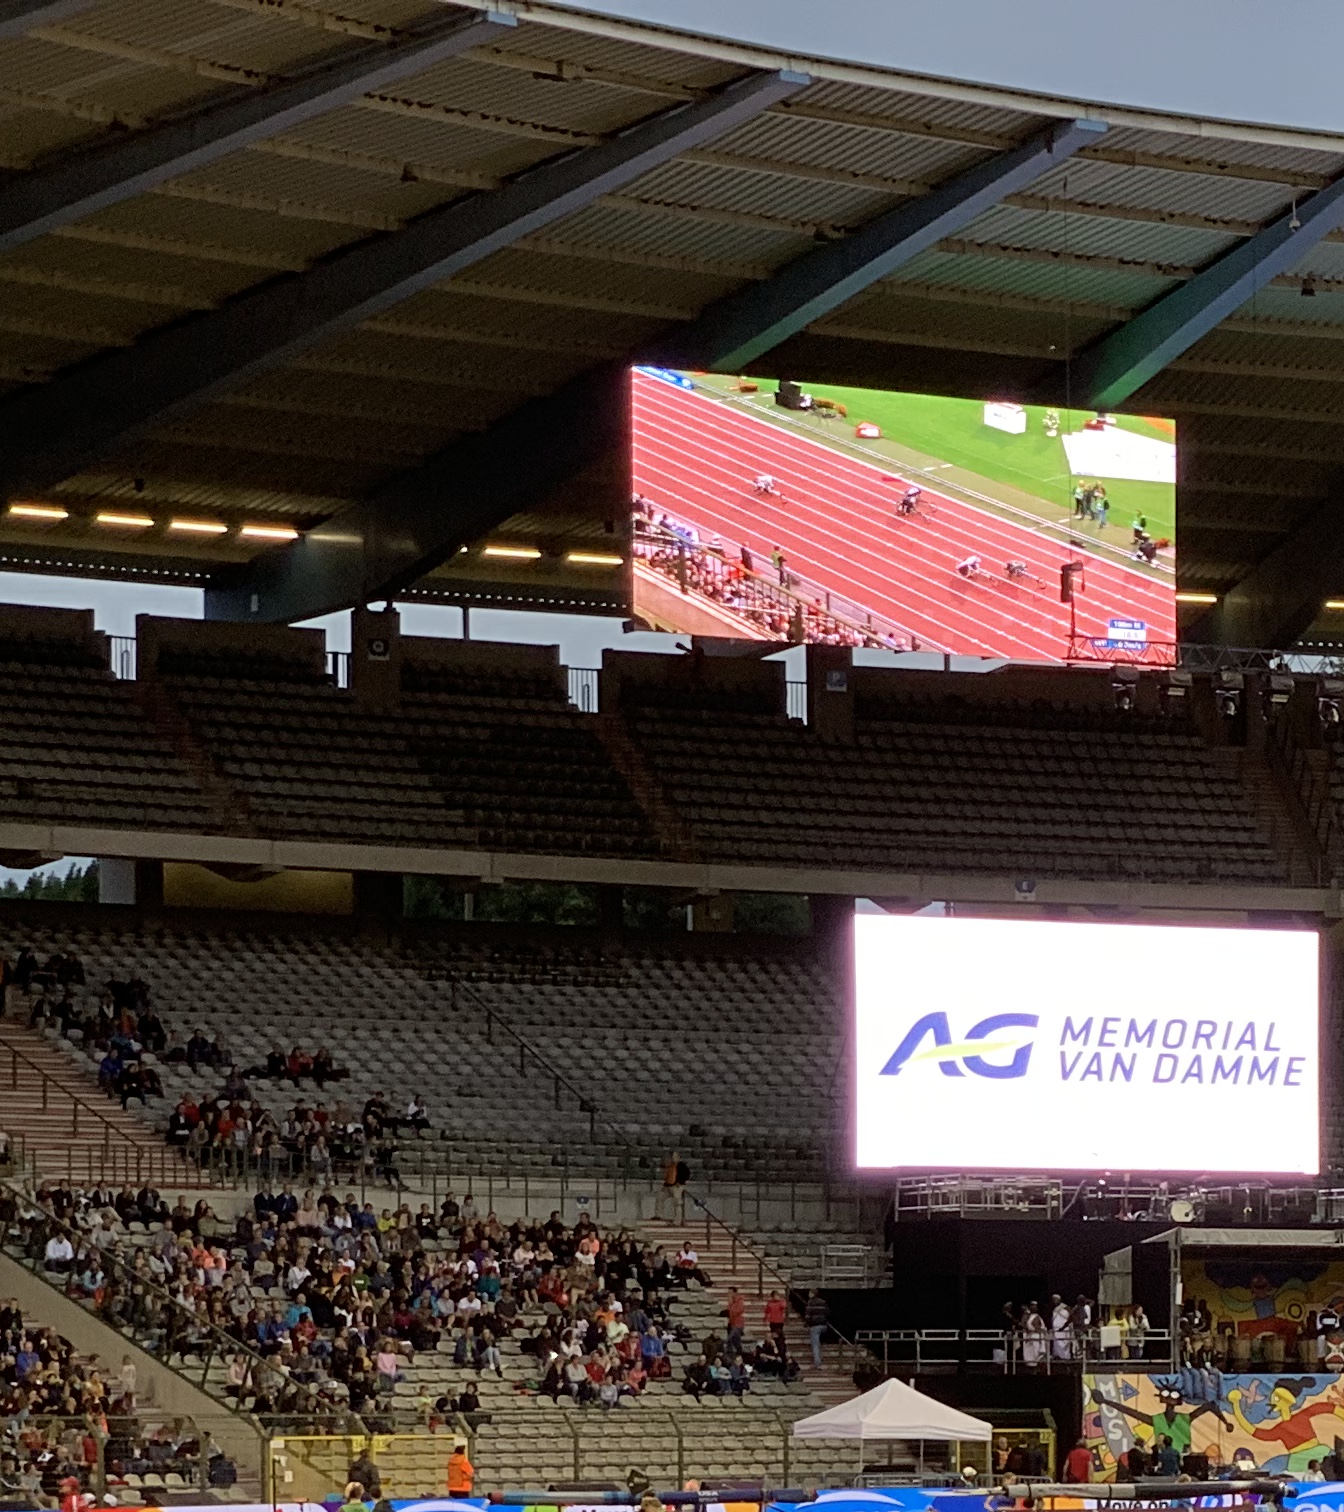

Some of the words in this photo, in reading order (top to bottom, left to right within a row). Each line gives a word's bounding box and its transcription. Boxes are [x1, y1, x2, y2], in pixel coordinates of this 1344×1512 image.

[879, 1011, 1039, 1080] AG
[1060, 1016, 1281, 1052] MEMORIAL
[1060, 1050, 1137, 1083] VAN
[1152, 1053, 1306, 1087] DAMME
